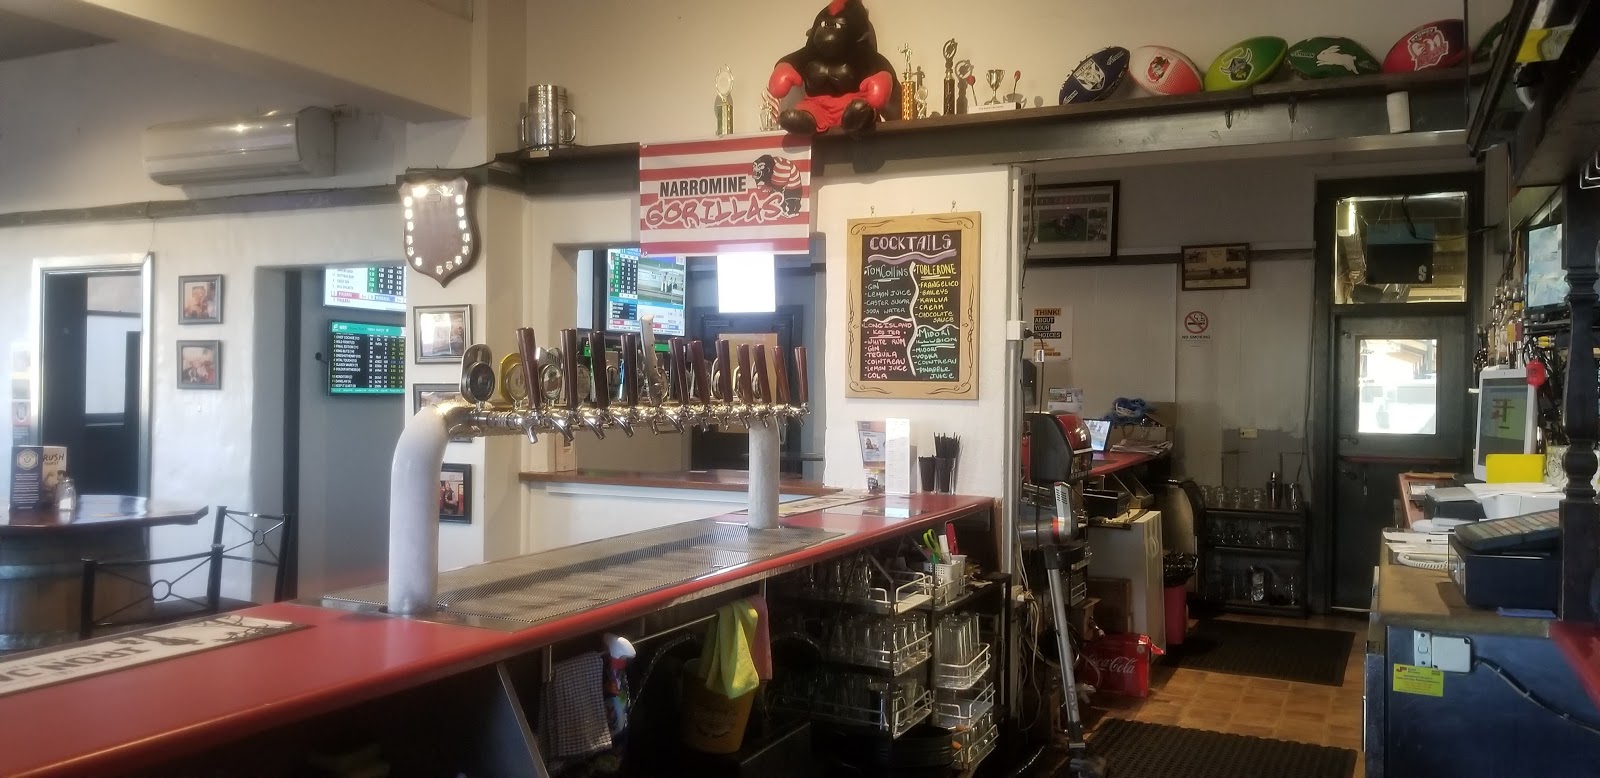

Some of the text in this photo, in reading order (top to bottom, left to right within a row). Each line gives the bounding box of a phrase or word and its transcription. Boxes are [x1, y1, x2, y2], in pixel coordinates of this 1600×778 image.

[659, 176, 747, 198] NARROMINE
[645, 194, 784, 228] GORILLAS
[869, 234, 952, 251] COCKTAILS
[916, 264, 956, 275] TOBLERONE
[868, 290, 888, 298] LEMON
[918, 327, 950, 338] MIDORI
[892, 338, 906, 347] RUM
[36, 646, 152, 670] IRON
